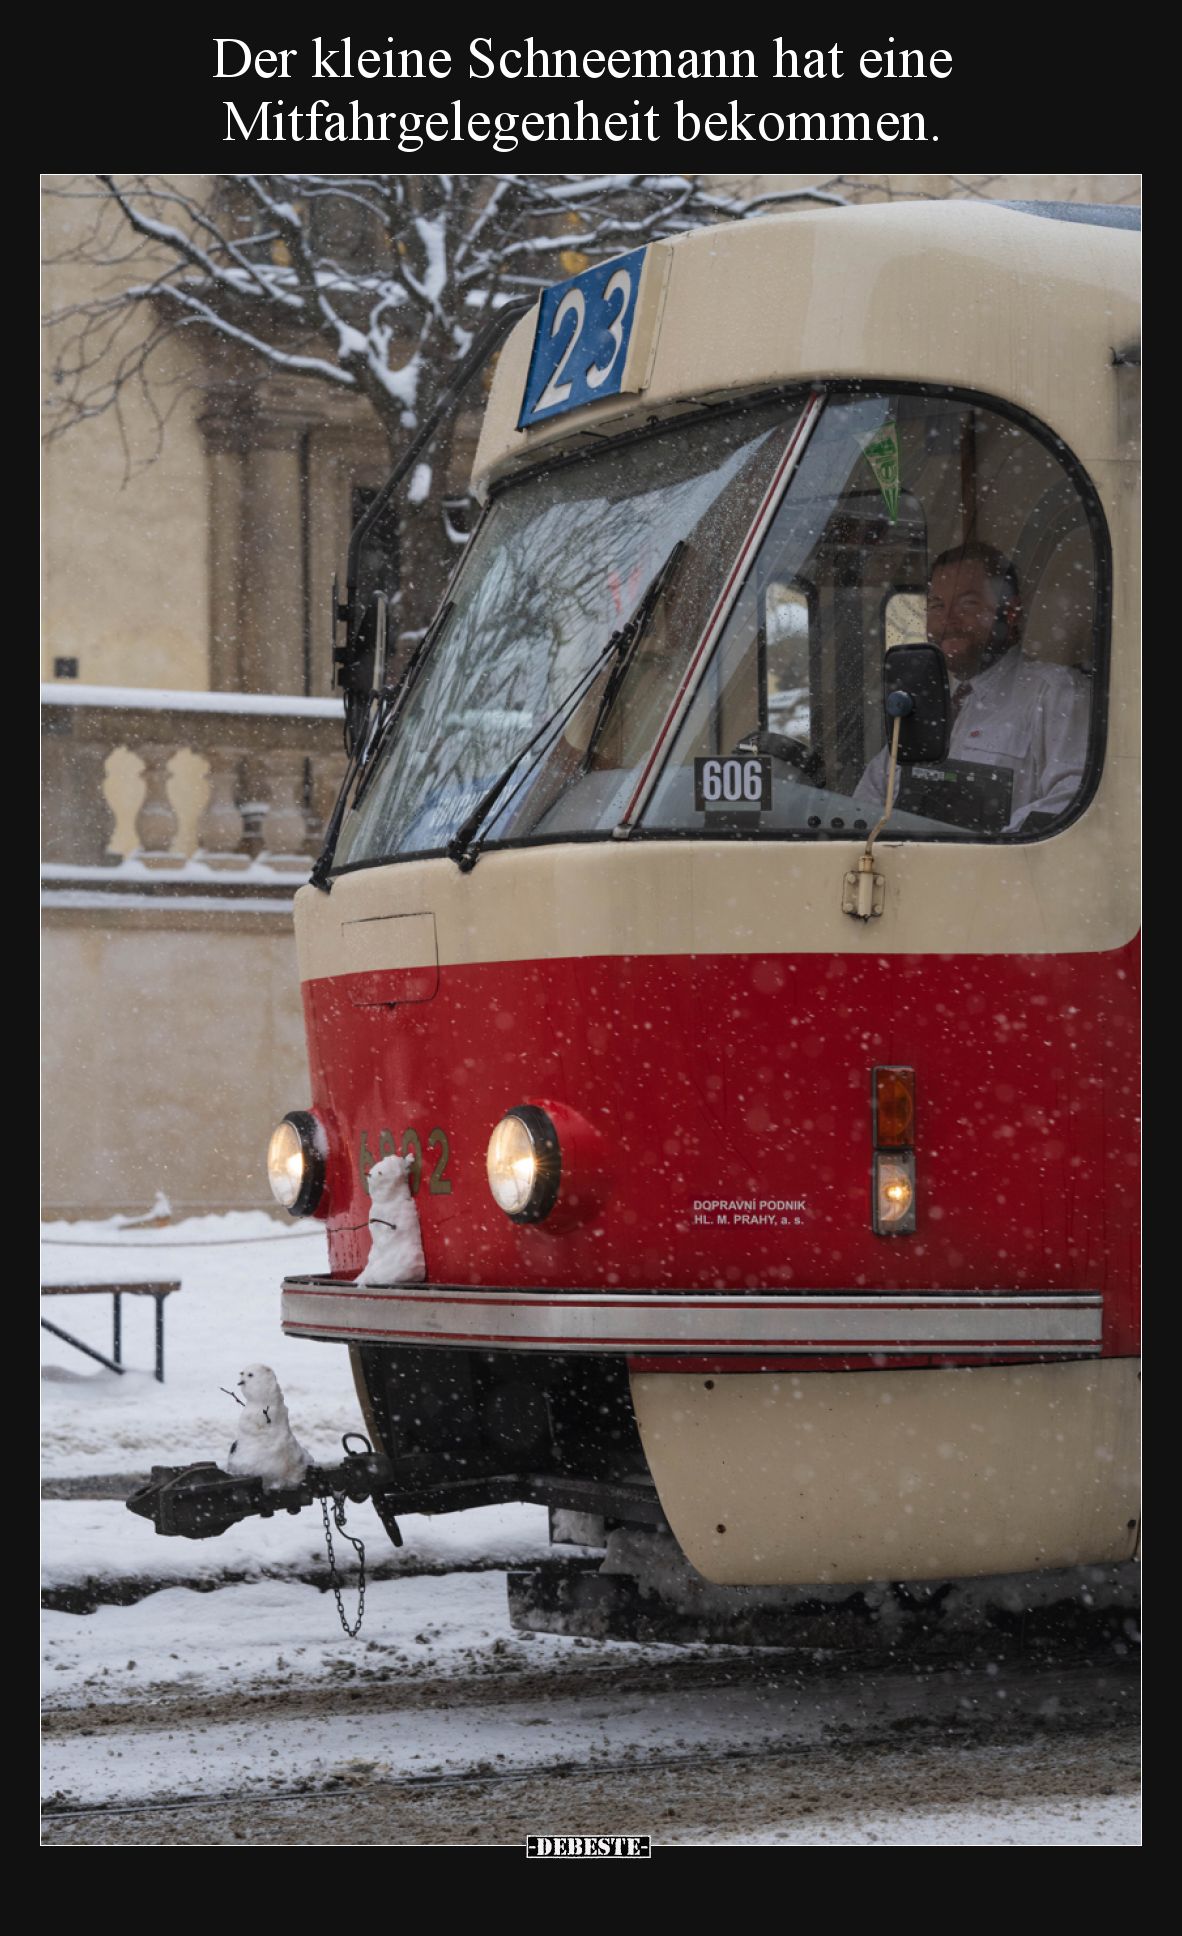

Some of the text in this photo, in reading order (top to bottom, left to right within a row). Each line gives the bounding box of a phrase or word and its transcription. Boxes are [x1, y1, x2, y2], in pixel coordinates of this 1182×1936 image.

[532, 268, 631, 413] 23
[703, 760, 762, 801] 606
[693, 1198, 806, 1211] DOPRAVNÍ PODNIK
[694, 1214, 714, 1225] HL.
[717, 1214, 731, 1225] M.
[734, 1214, 778, 1227] PRAHY,
